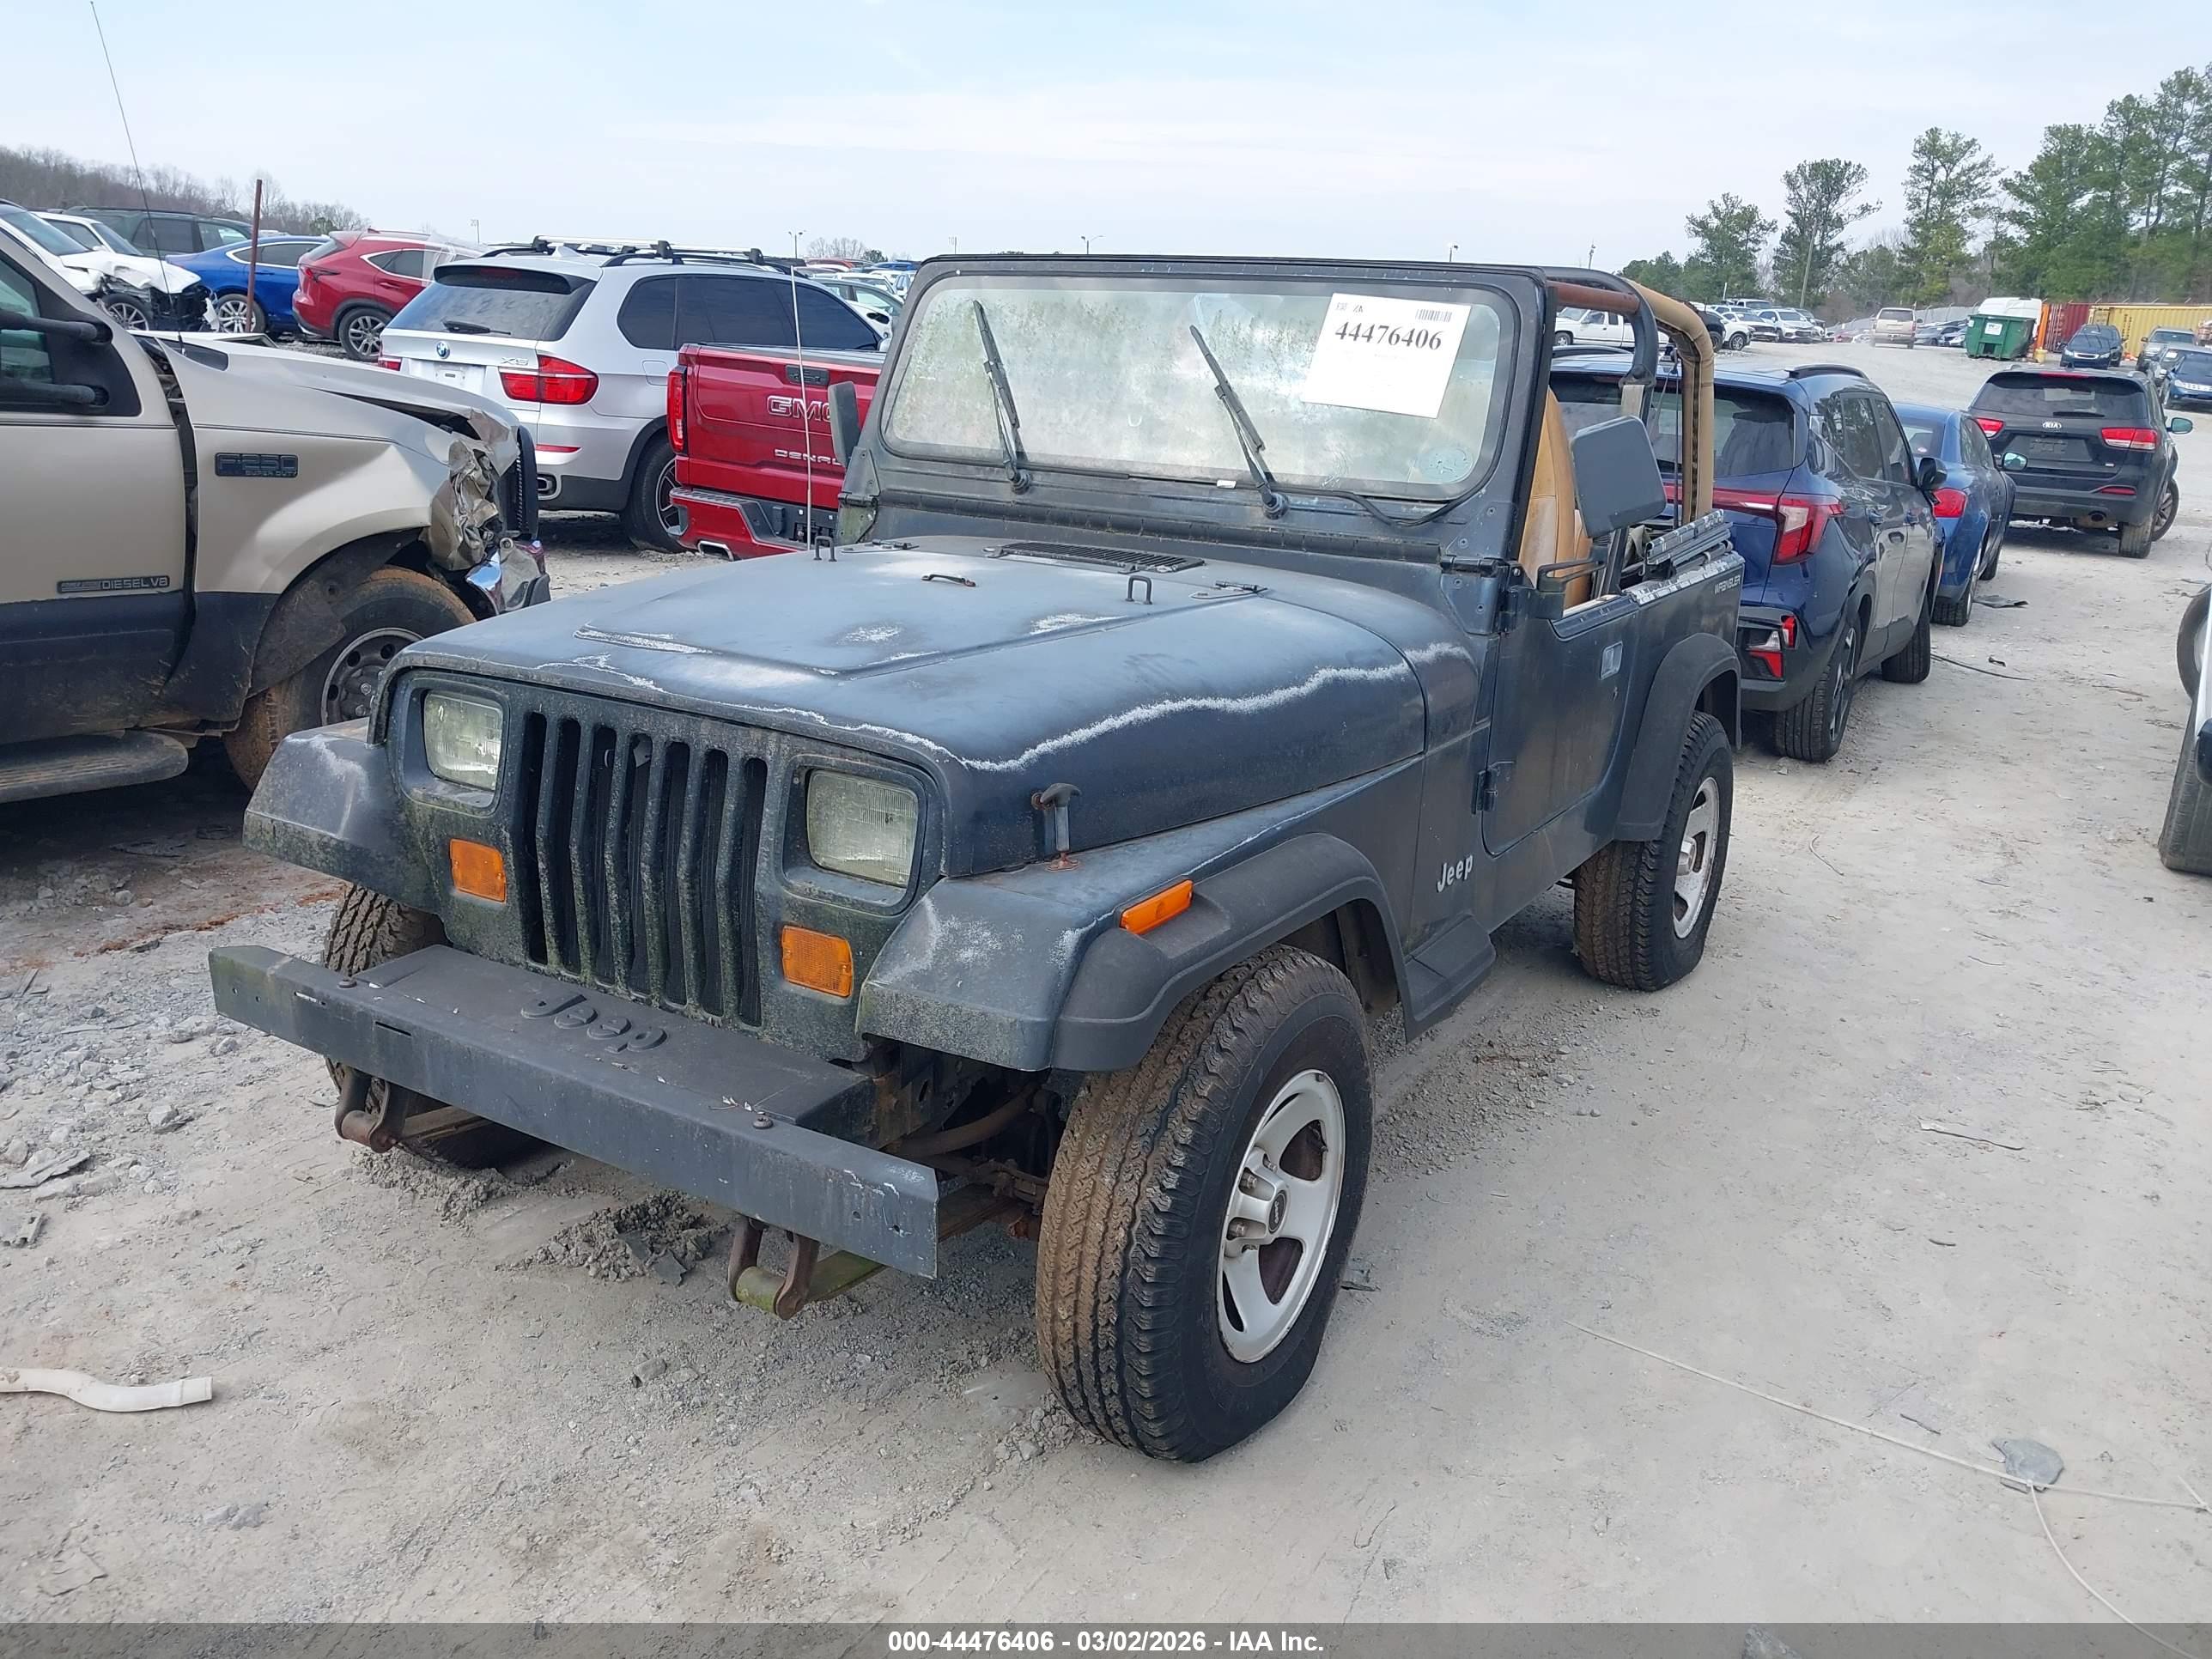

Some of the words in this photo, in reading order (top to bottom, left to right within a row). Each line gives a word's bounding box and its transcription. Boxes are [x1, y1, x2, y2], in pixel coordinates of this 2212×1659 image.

[1335, 322, 1443, 349] 44476406
[501, 356, 529, 366] X5
[775, 448, 842, 466] DENAL
[102, 580, 149, 590] DIESEL
[150, 577, 167, 587] V8
[1437, 854, 1474, 893] Jeep
[521, 994, 667, 1053] Jeep
